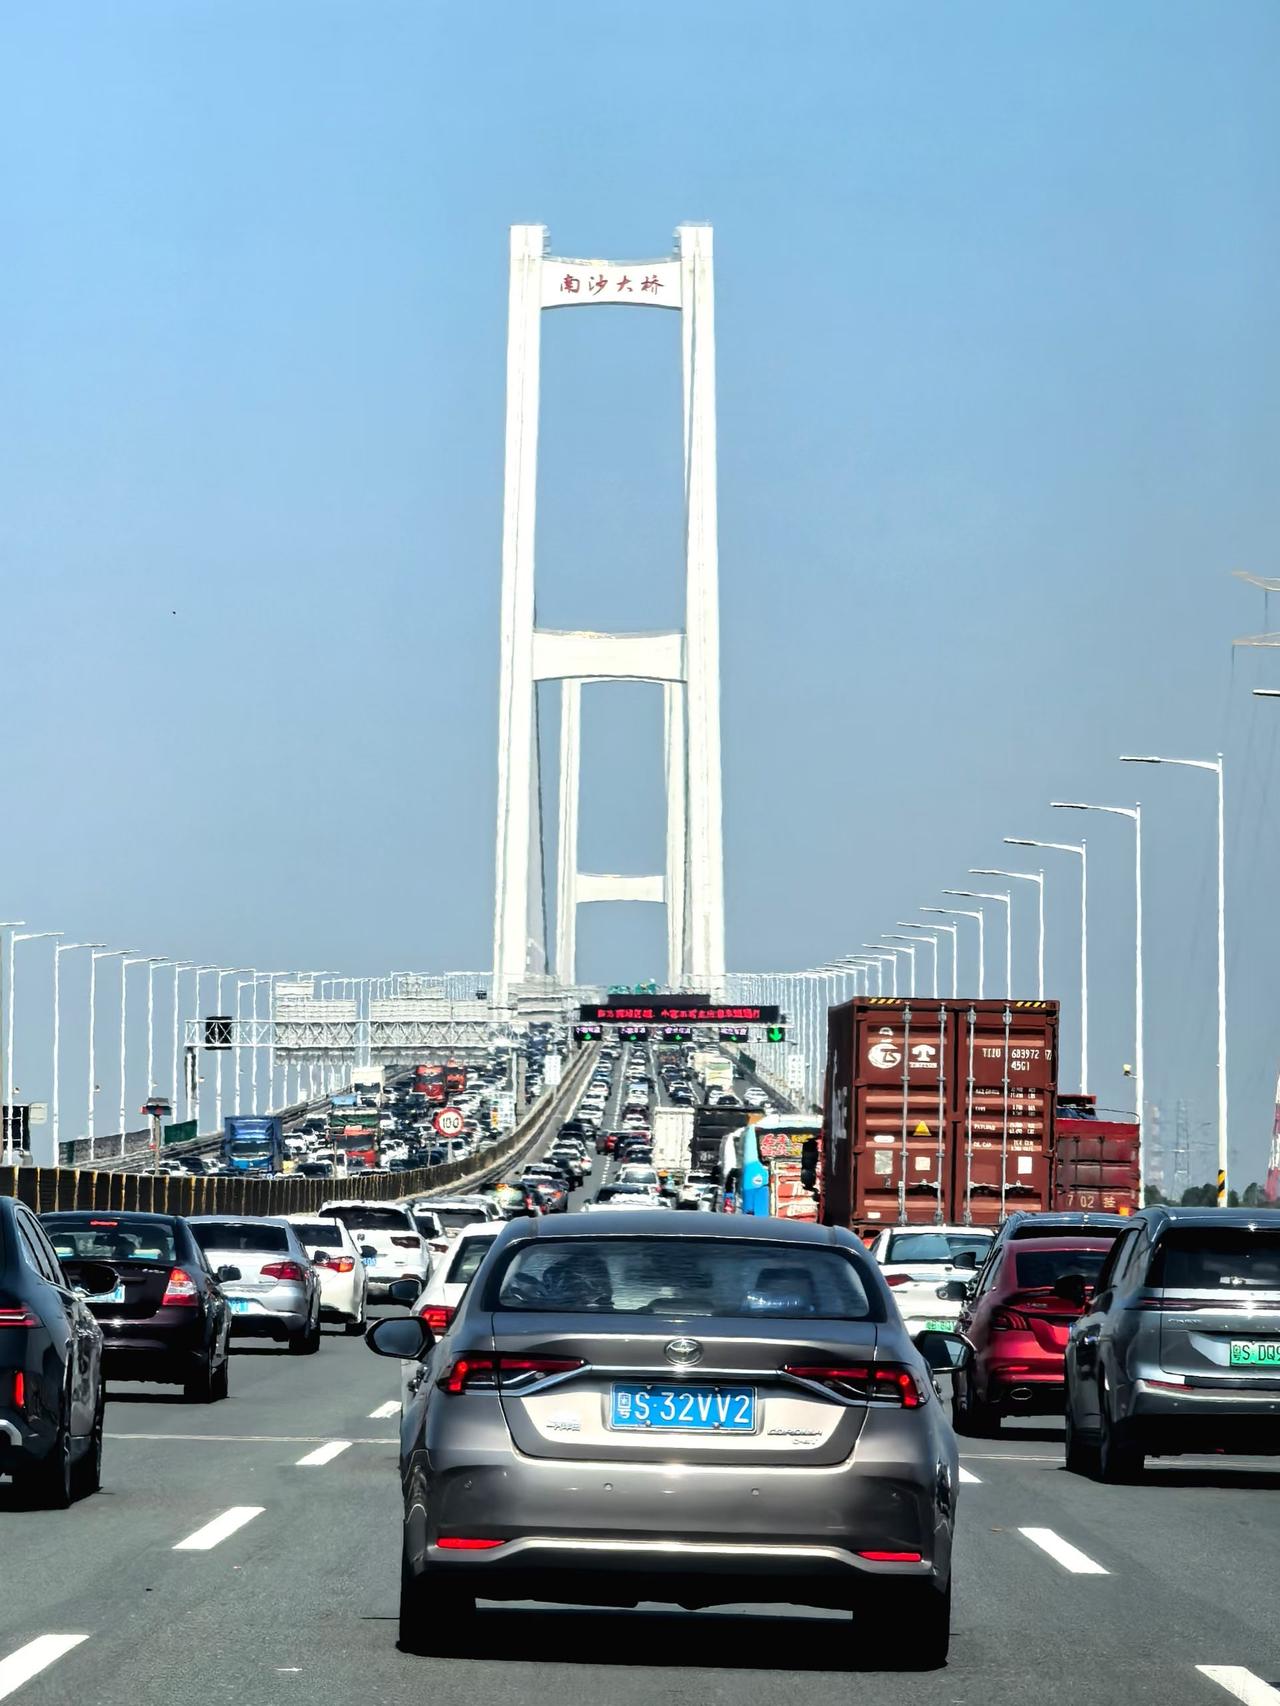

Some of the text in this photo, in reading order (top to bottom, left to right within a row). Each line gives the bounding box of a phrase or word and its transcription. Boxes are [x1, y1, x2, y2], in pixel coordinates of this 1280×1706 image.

[560, 273, 664, 296] 南沙大桥
[1011, 1049, 1040, 1060] 683972
[1011, 1060, 1030, 1071] 45G1
[442, 1117, 460, 1129] 100
